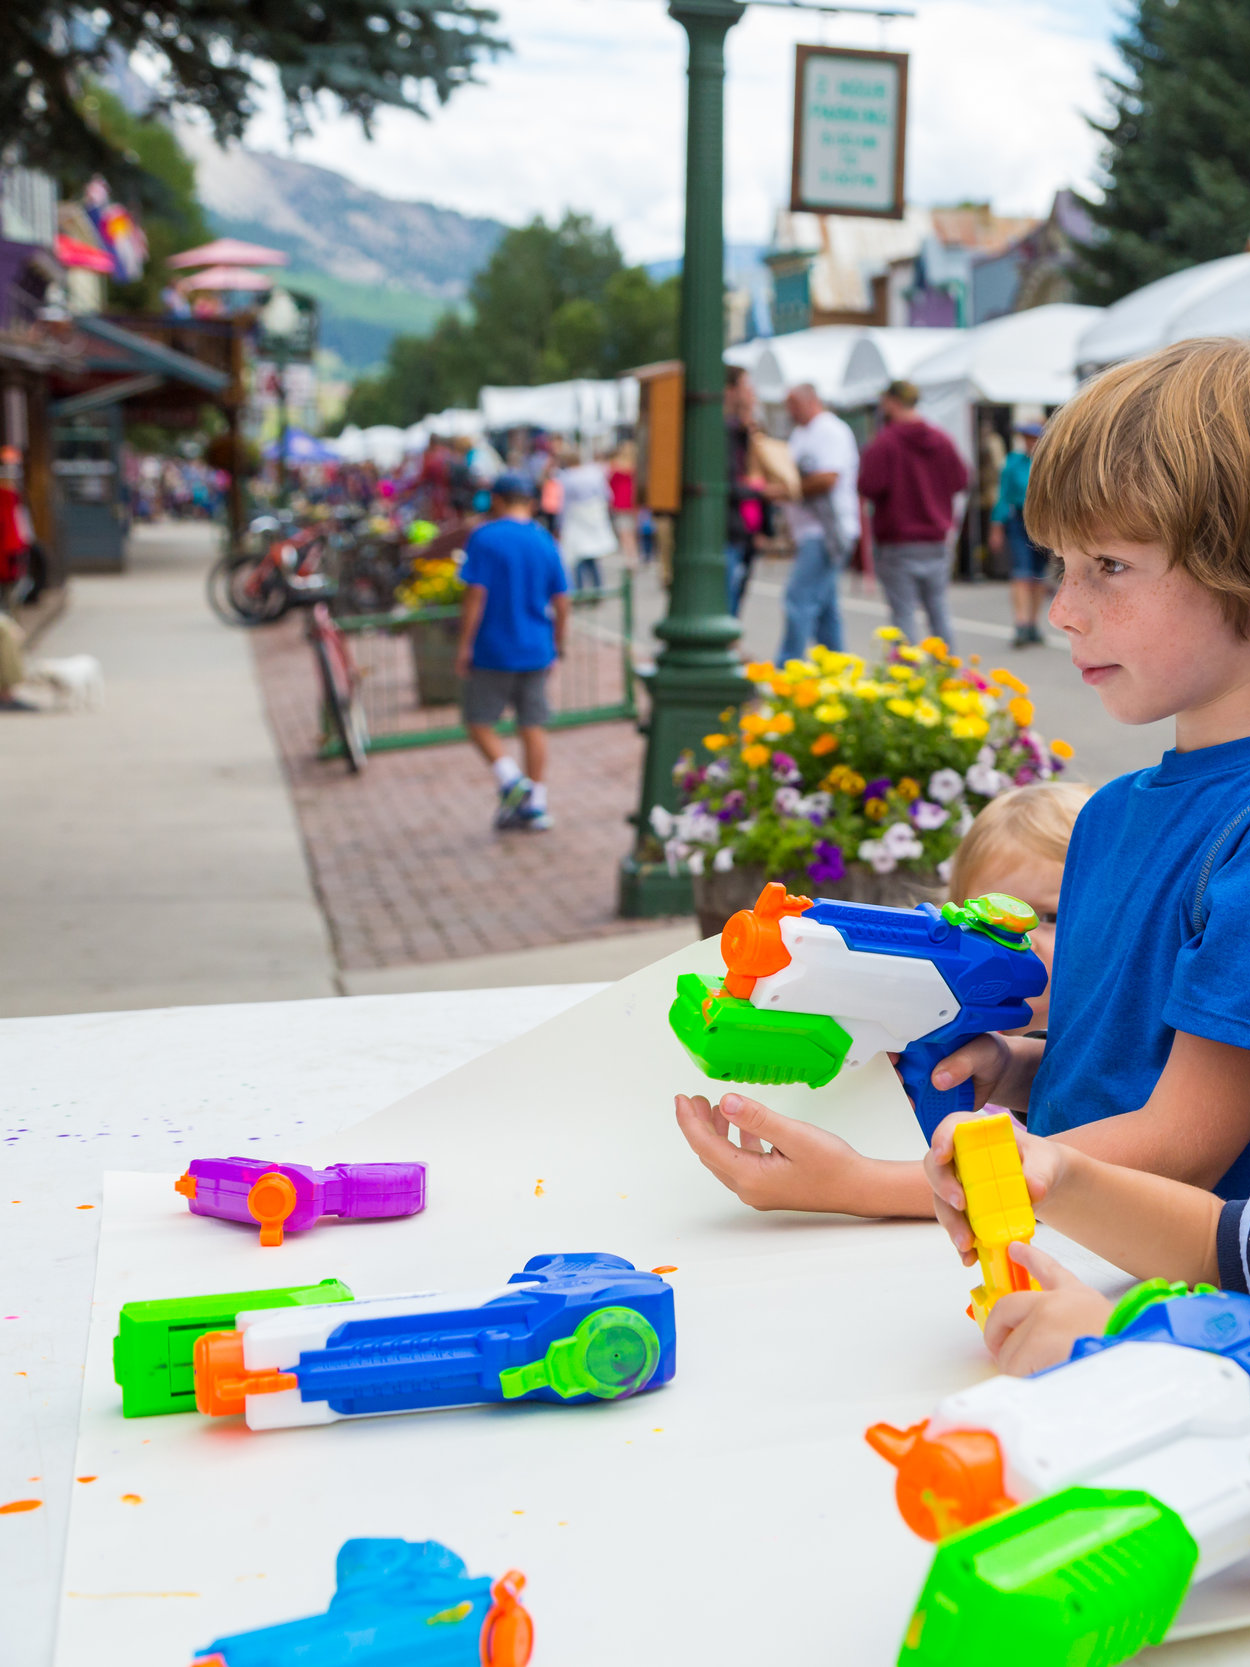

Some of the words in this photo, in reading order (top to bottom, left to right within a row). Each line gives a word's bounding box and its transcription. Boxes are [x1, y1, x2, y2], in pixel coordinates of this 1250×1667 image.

[810, 103, 888, 126] PARKING
[833, 906, 908, 926] MICROBURST
[966, 980, 1009, 999] NERF
